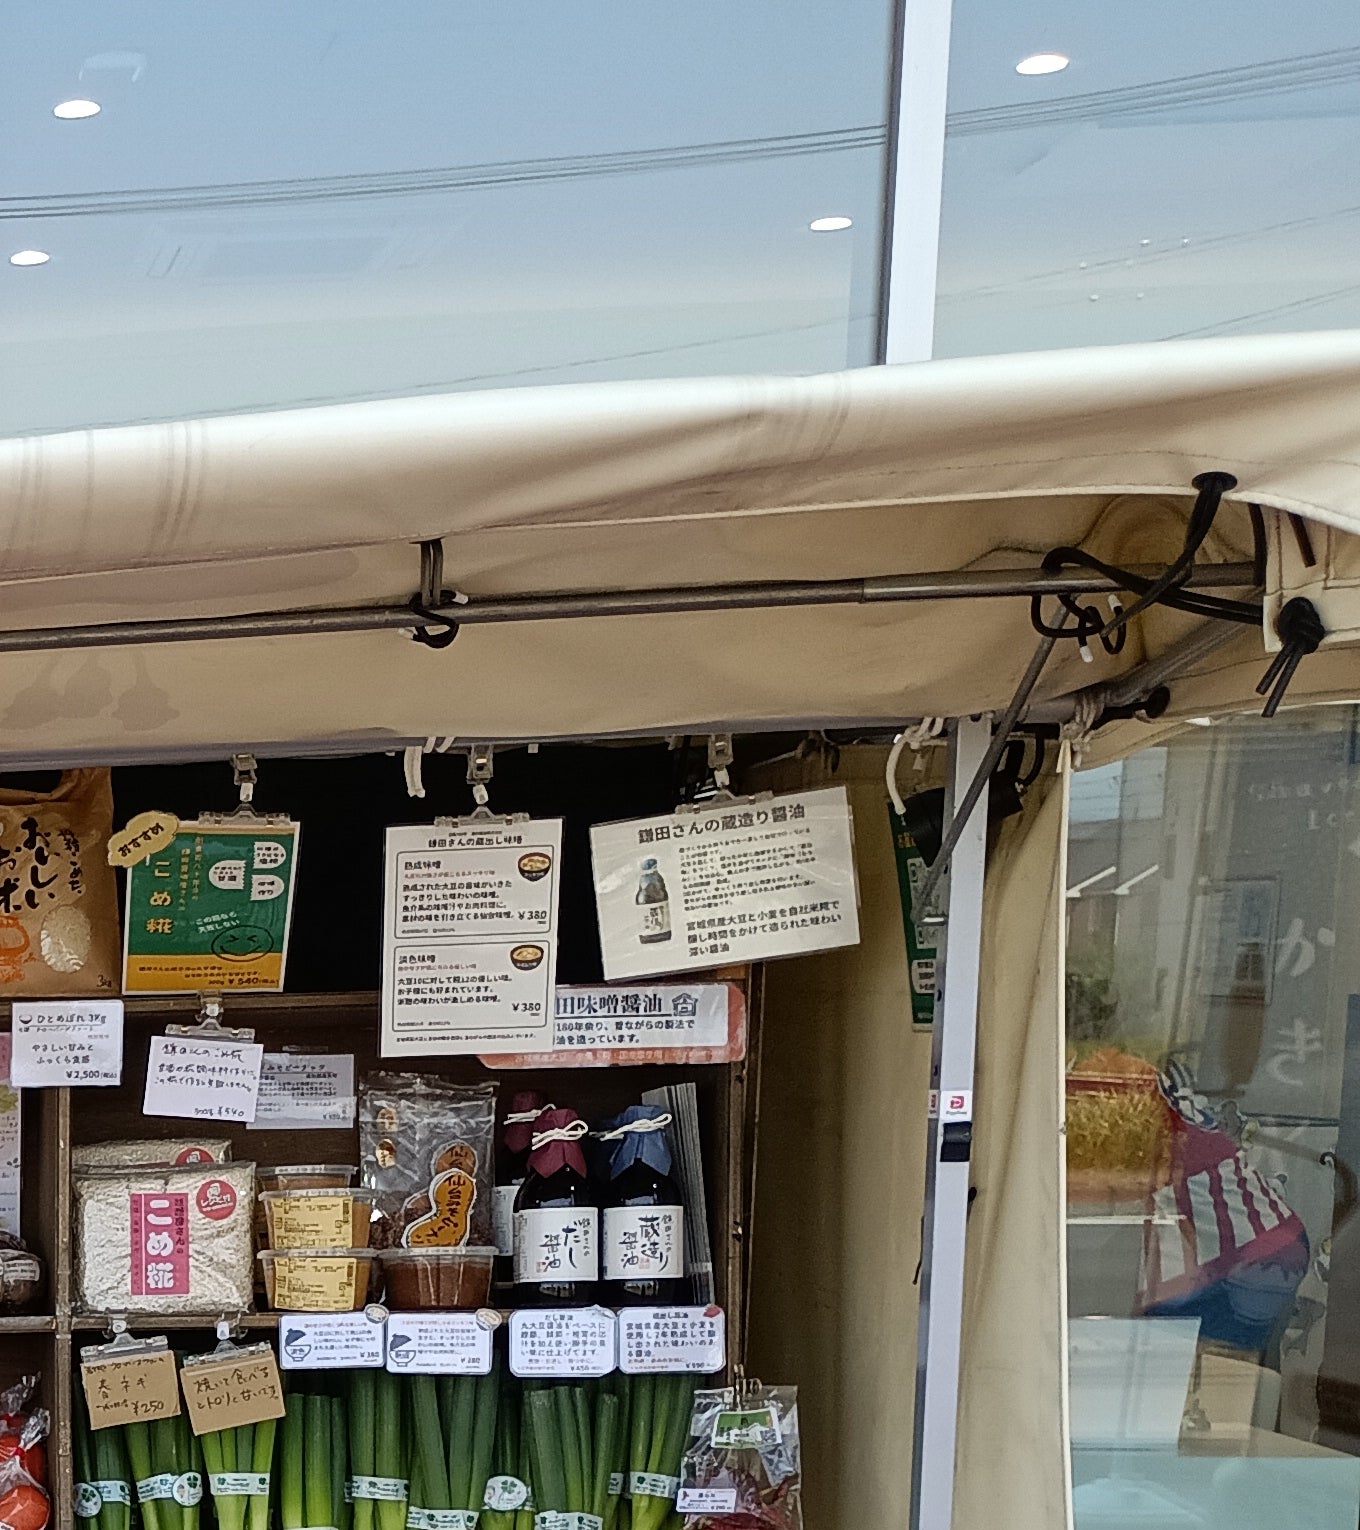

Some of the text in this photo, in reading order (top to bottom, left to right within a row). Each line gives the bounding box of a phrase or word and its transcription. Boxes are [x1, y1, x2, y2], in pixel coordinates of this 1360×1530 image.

[117, 822, 166, 858] おすすめ
[637, 802, 807, 845] 鎌田さんの蔵造り醤油
[21, 816, 59, 910] おいしい
[37, 1013, 85, 1024] ひとめぼれ
[65, 1070, 100, 1081] ¥2,500
[561, 1220, 582, 1270] だし
[132, 1400, 165, 1416] ¥250
